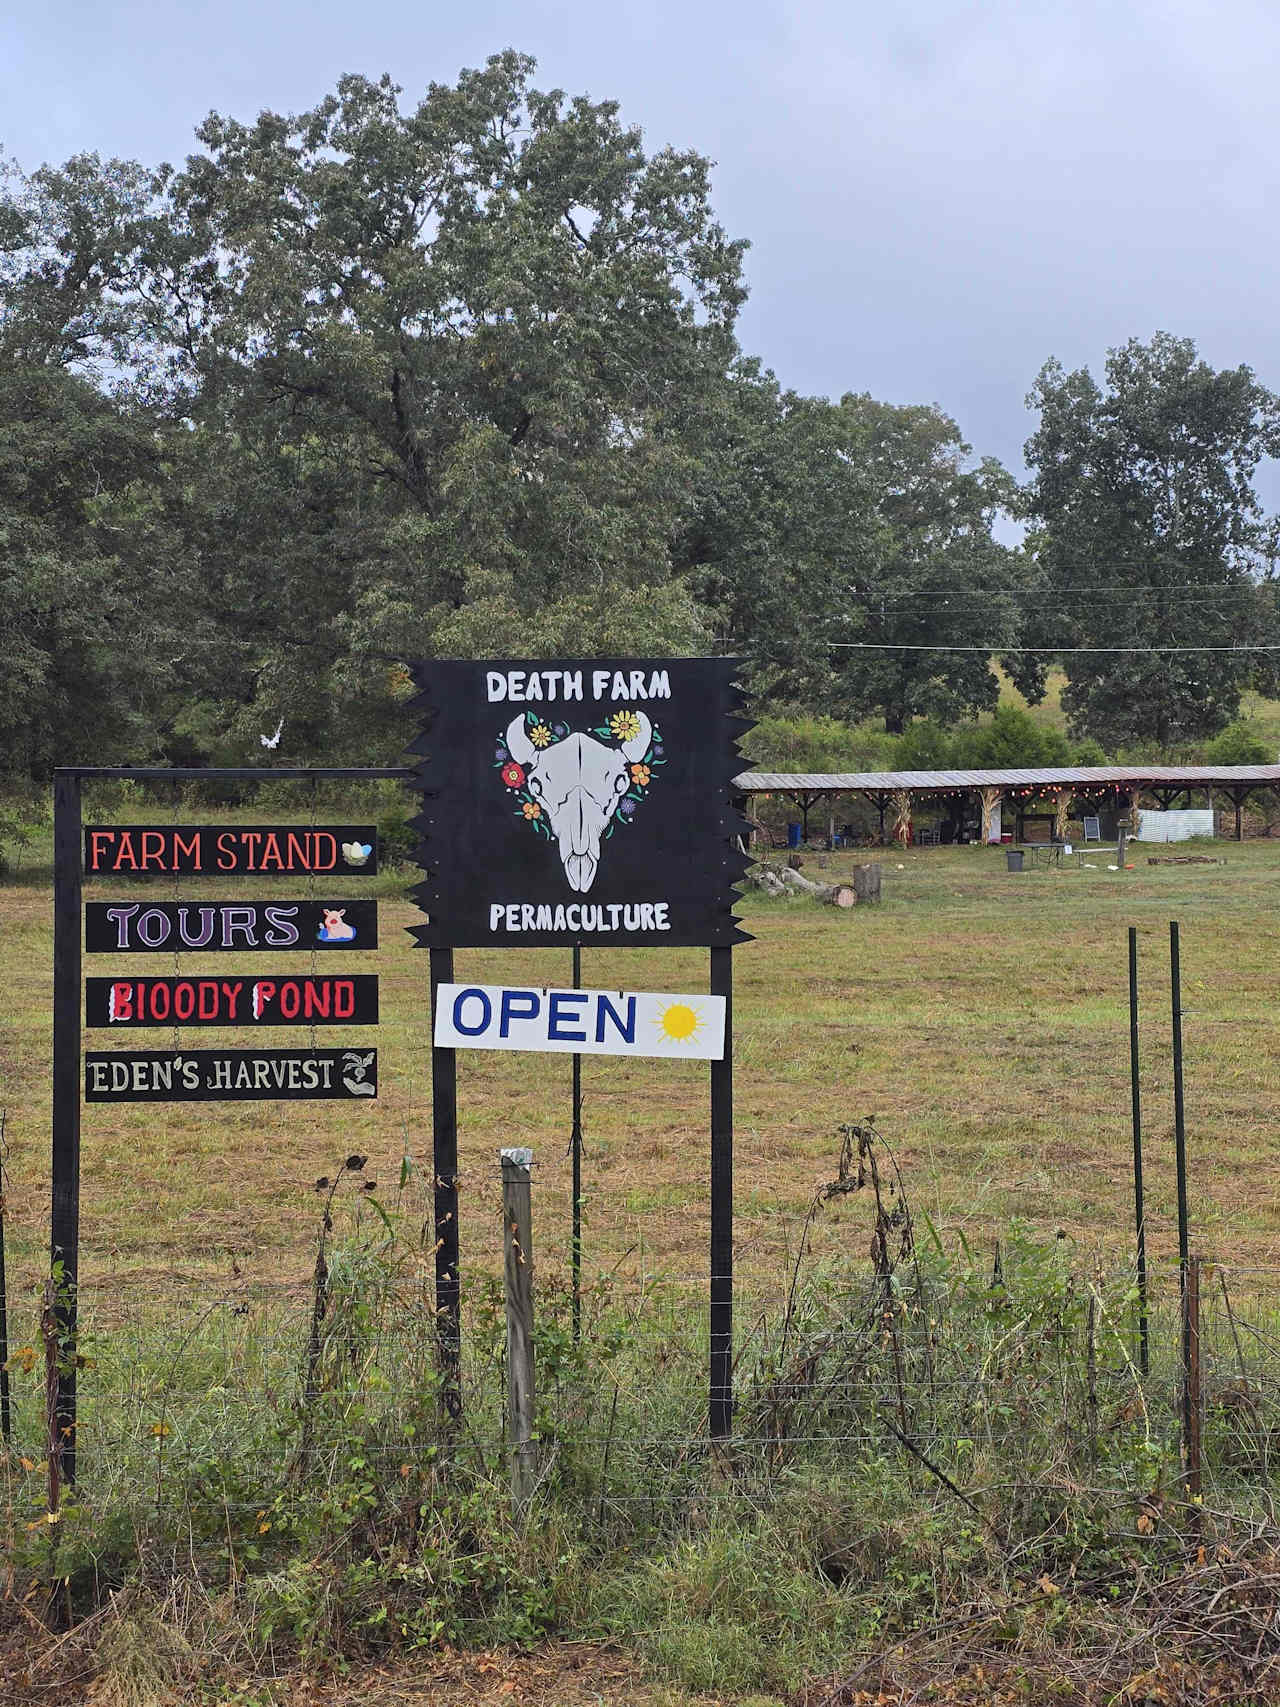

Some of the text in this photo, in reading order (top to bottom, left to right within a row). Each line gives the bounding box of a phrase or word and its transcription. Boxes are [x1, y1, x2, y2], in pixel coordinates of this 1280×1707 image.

[487, 670, 672, 702] DEATH FARM
[91, 831, 337, 870] FARM STAND
[106, 903, 299, 948] TOURS
[489, 902, 672, 932] PERMACULTURE
[252, 980, 355, 1020] POND
[452, 988, 637, 1044] OPEN
[86, 1056, 335, 1092] EDEN'S HARVEST
